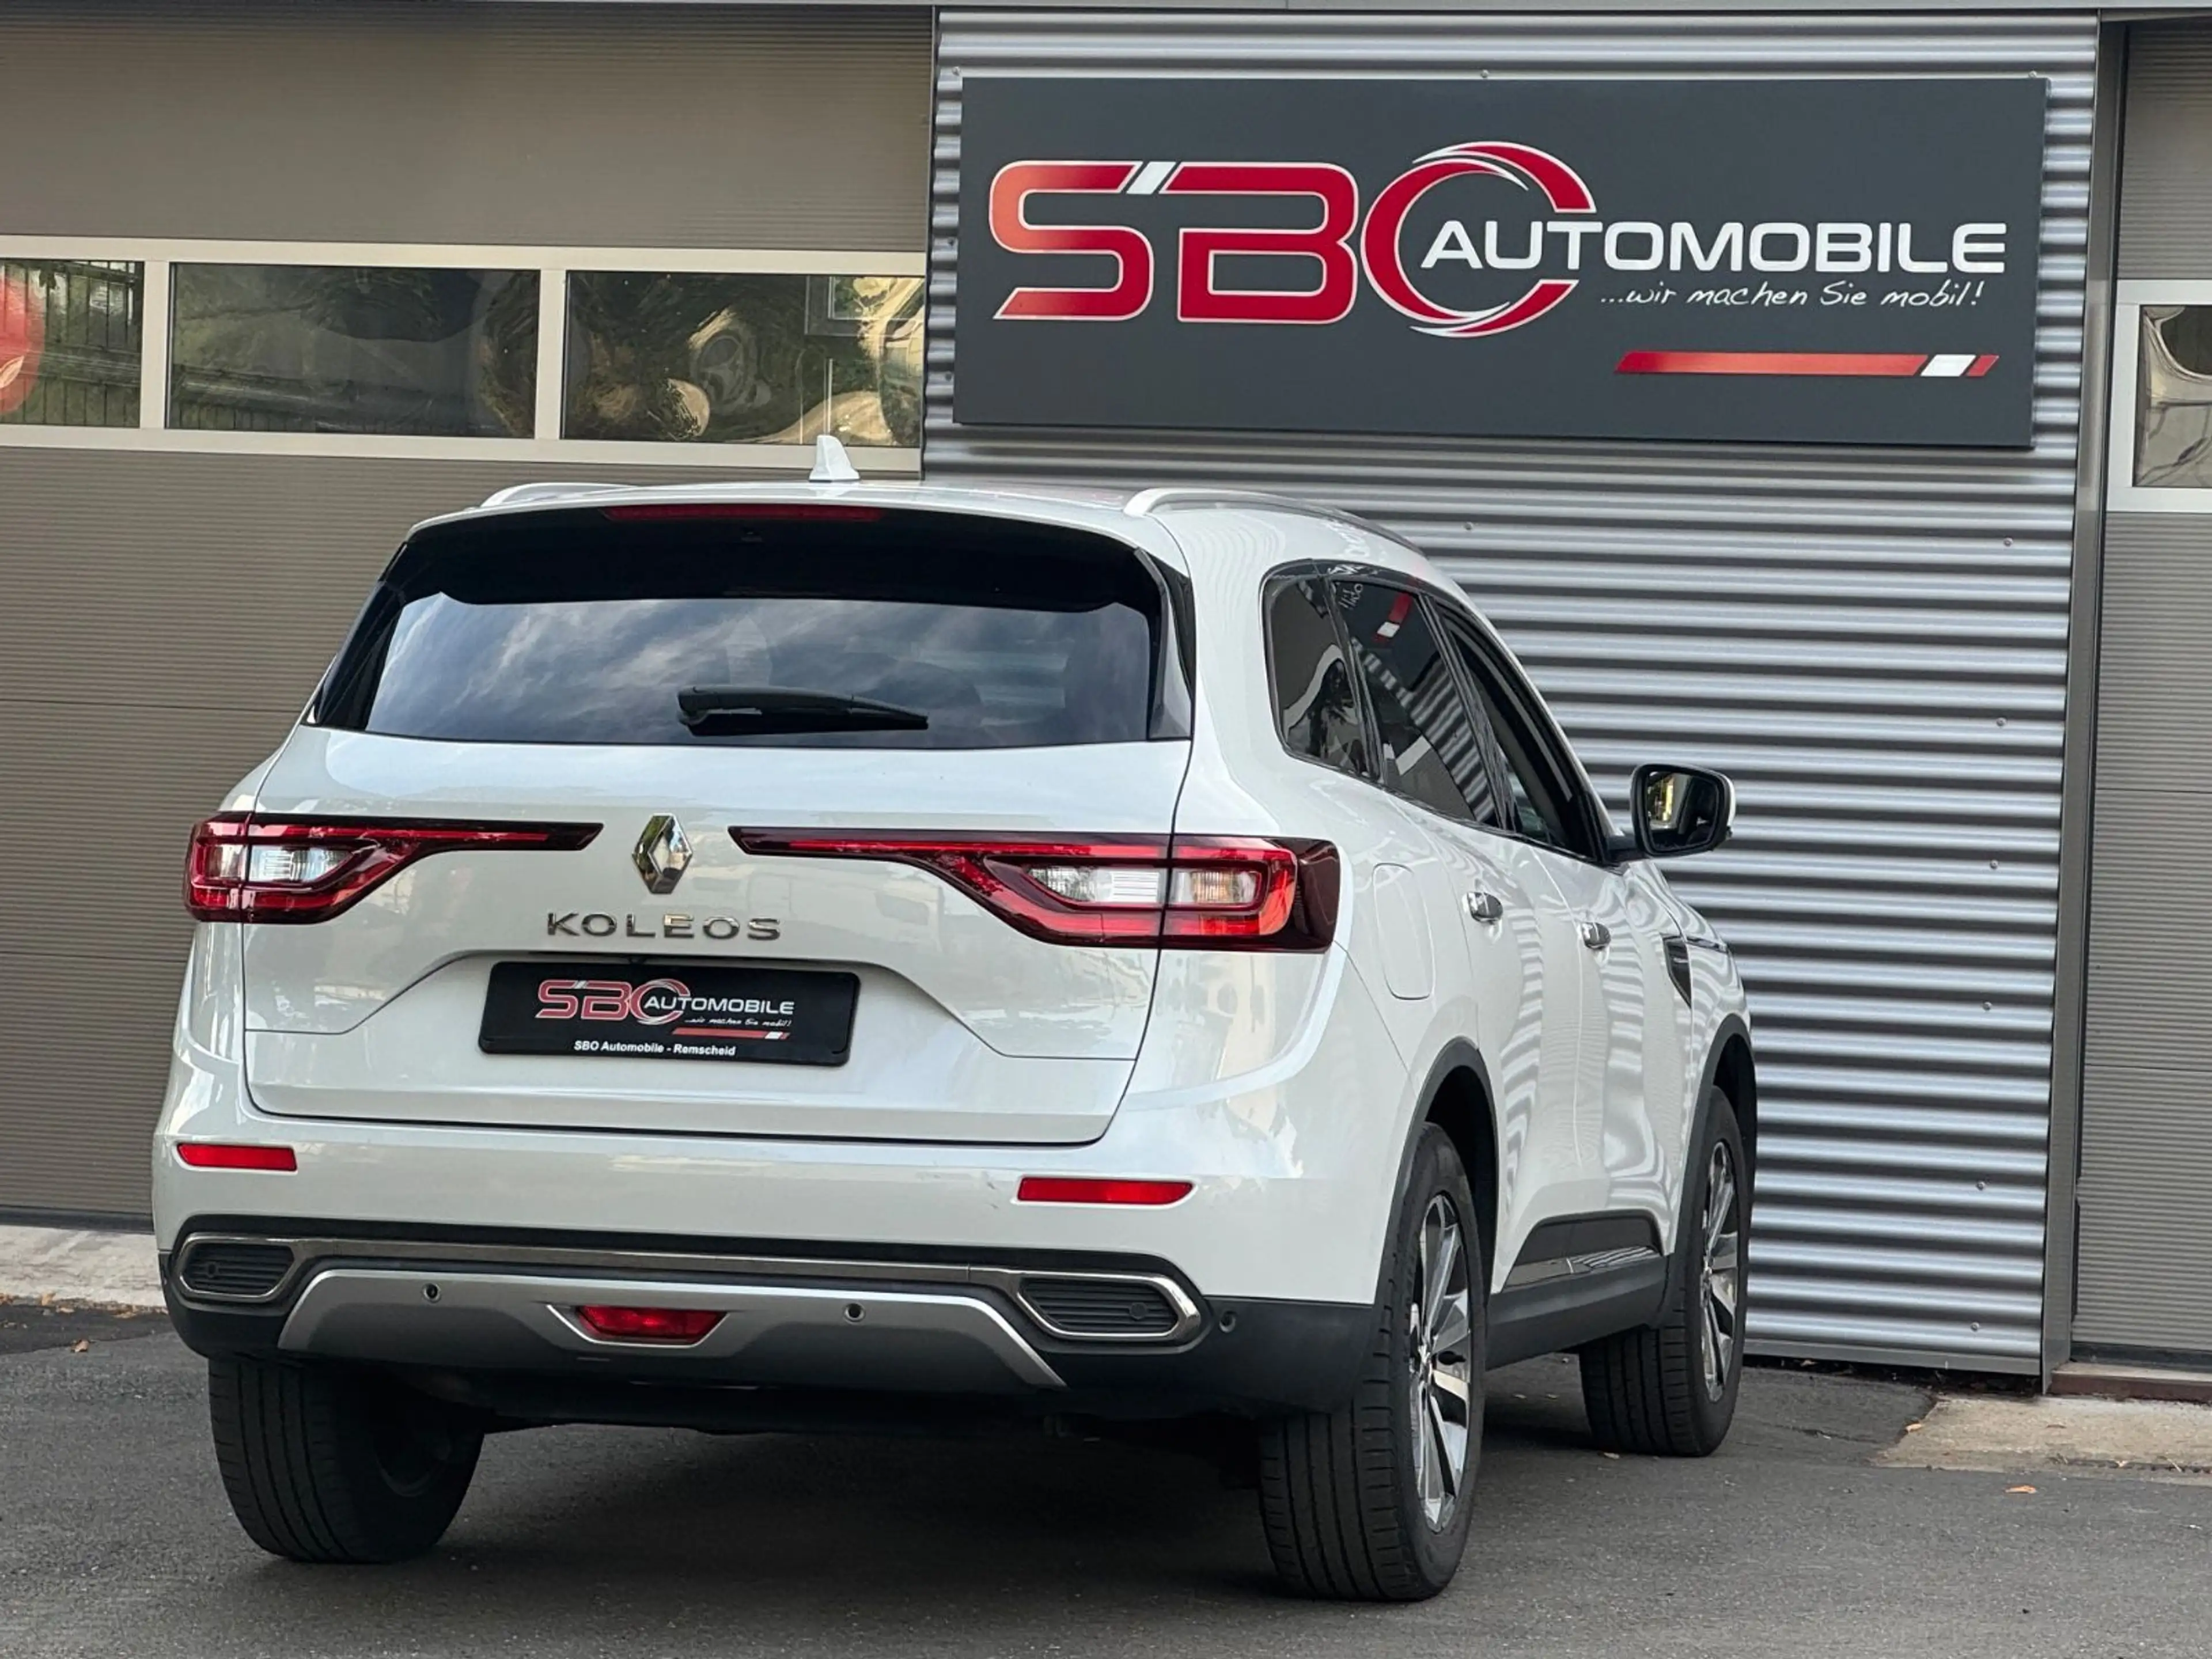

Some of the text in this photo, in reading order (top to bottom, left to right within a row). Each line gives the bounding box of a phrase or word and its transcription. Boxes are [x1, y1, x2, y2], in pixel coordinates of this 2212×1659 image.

[1420, 219, 2008, 274] AUTOMOBILE
[1686, 281, 1808, 308] machen
[1820, 280, 1867, 306] Sie
[1880, 279, 1985, 307] mobil!
[547, 912, 781, 941] KOLEOS
[643, 995, 795, 1015] AUTOMOBILE
[574, 1040, 599, 1051] SBO
[600, 1041, 664, 1053] Automobile
[673, 1043, 736, 1055] Remscheid
